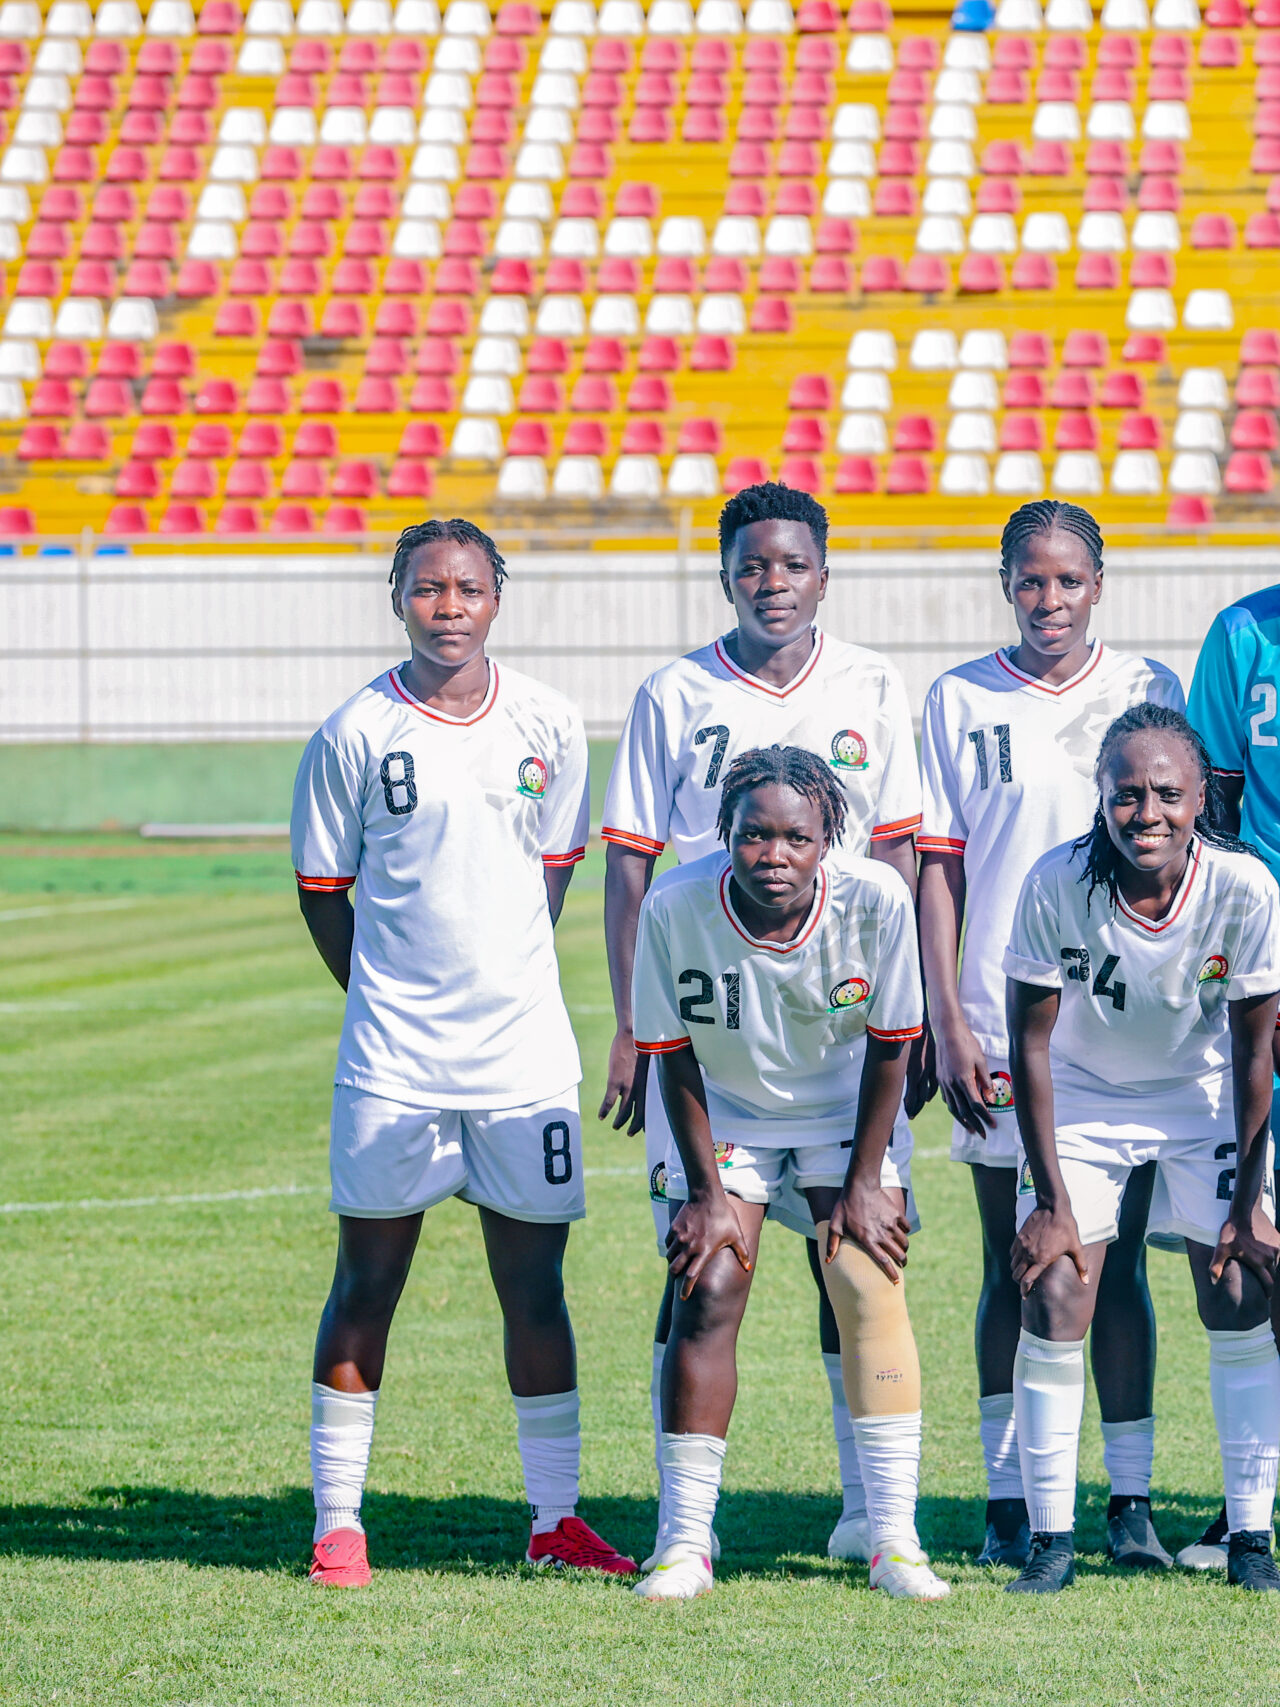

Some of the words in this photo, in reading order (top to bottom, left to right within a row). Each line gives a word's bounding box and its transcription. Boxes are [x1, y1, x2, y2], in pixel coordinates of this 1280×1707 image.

[379, 751, 418, 816] 8
[694, 725, 731, 790] 7
[967, 724, 1013, 790] 11
[677, 967, 741, 1031] 21
[542, 1120, 573, 1186] 8
